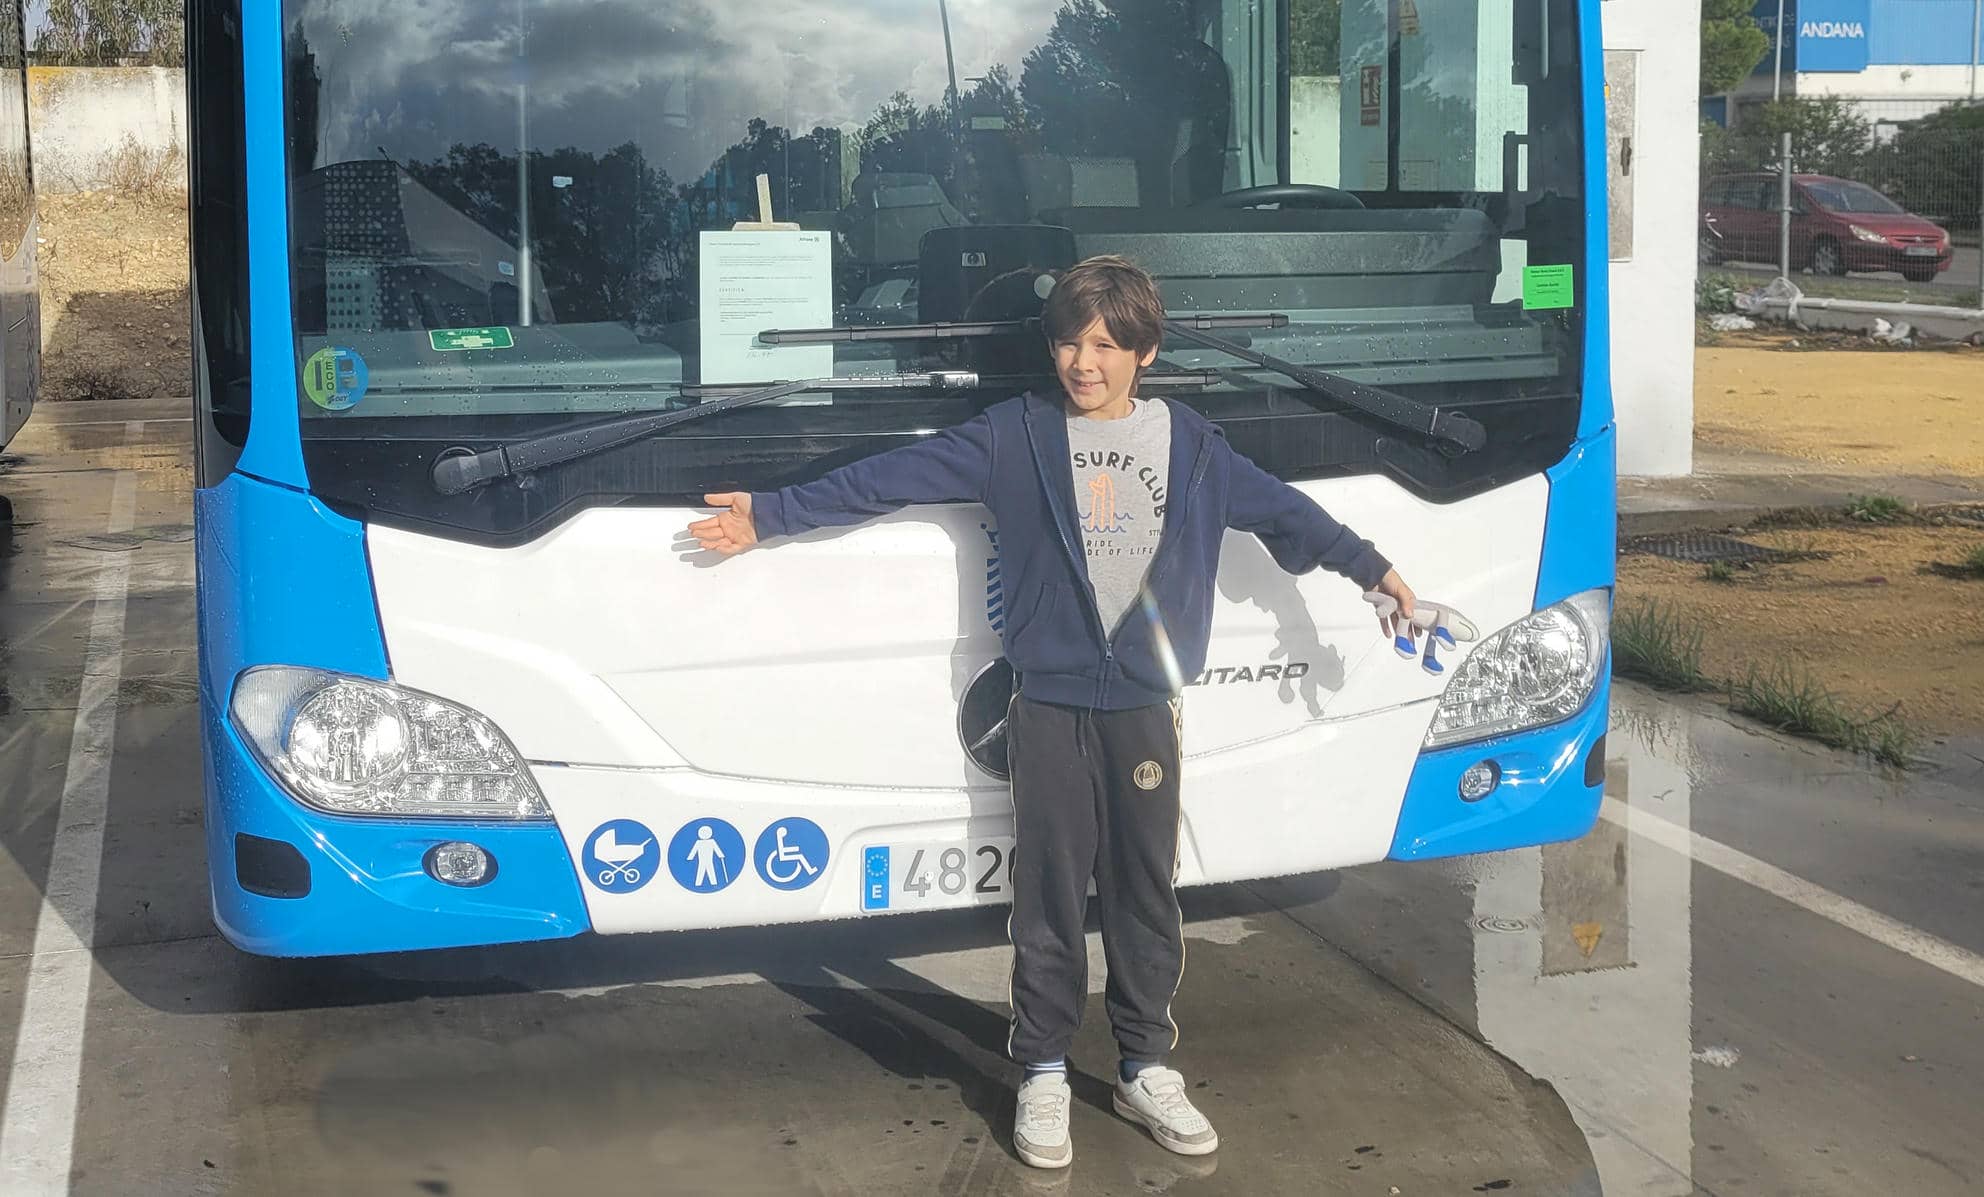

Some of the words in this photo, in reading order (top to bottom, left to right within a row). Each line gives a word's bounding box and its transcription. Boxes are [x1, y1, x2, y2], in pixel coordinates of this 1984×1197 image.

[1800, 21, 1864, 38] ANDANA
[326, 361, 335, 391] ECO
[1073, 451, 1135, 472] SURF
[1138, 466, 1168, 518] CLUB
[1086, 539, 1113, 548] RIDE
[1109, 548, 1121, 556] OF
[1130, 546, 1153, 555] LIFE
[871, 884, 883, 900] E
